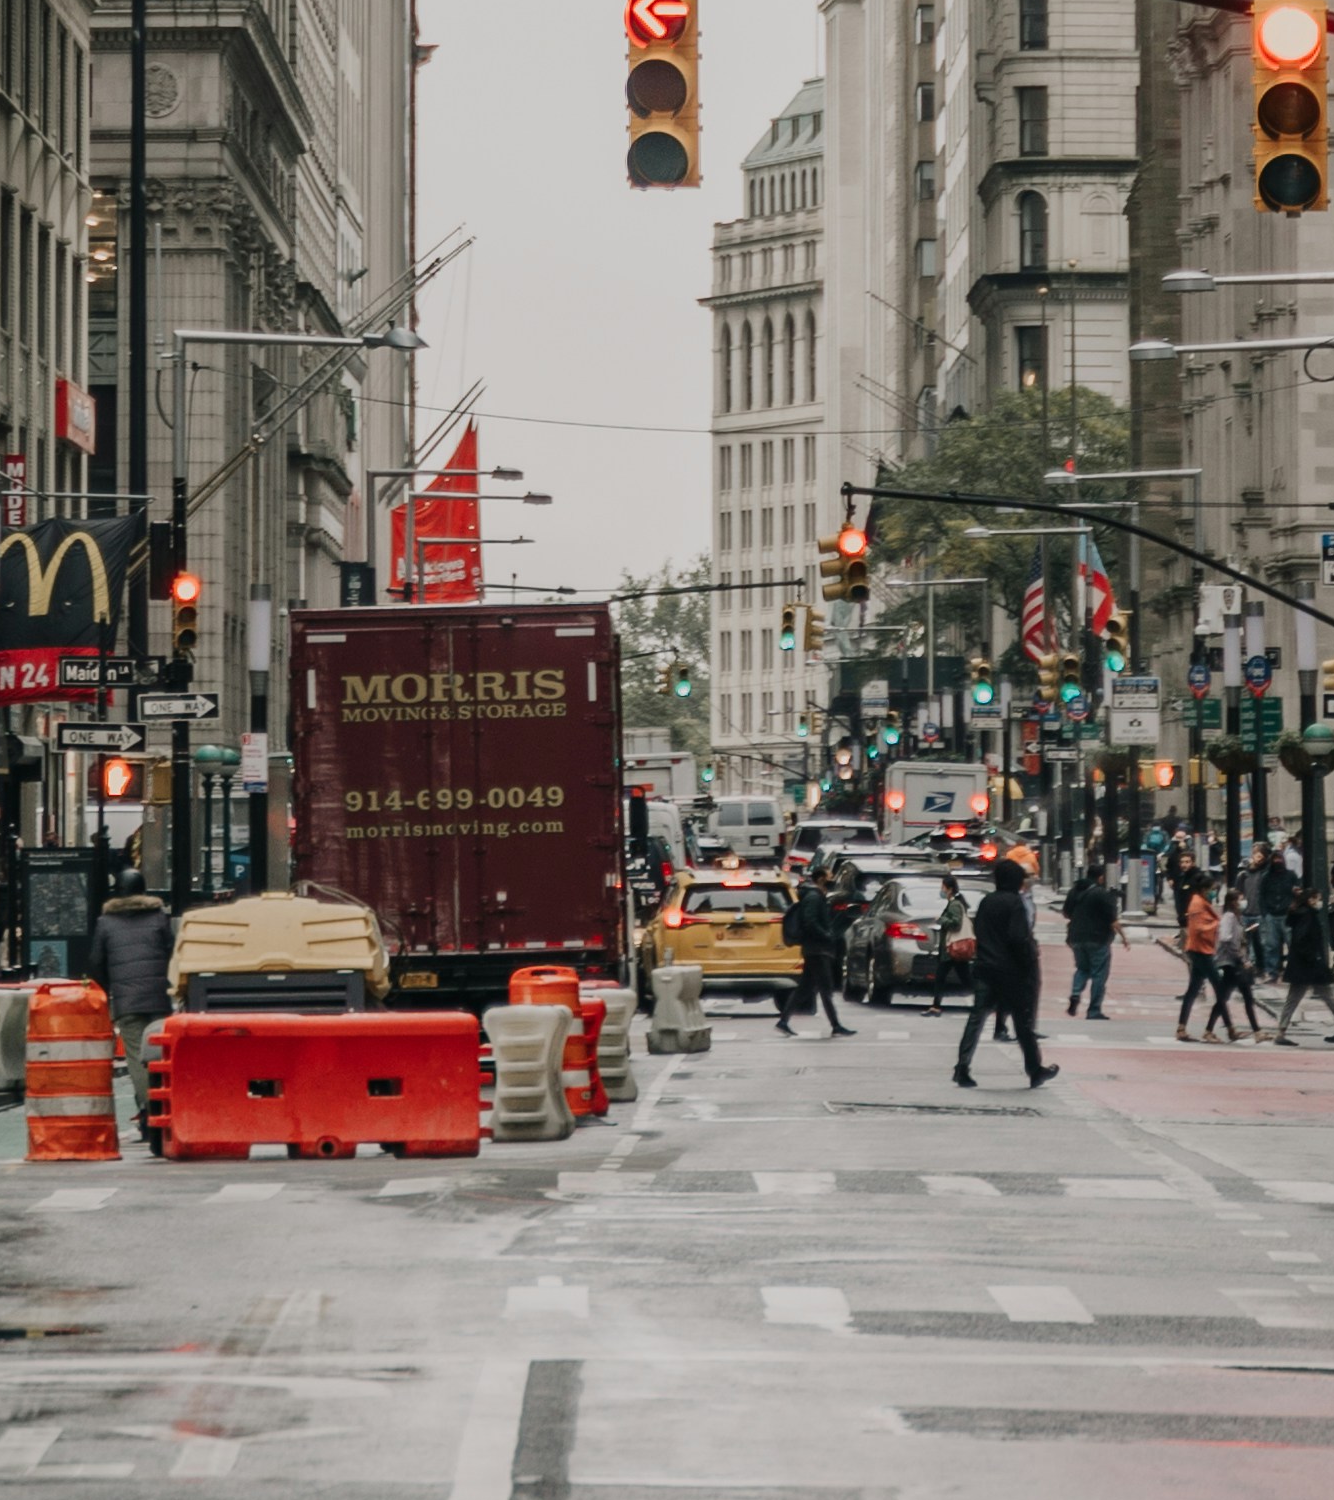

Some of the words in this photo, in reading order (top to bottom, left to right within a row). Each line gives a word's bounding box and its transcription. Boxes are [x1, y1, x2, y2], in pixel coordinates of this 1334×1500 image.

[20, 662, 50, 689] 24
[65, 661, 117, 681] Maidn
[341, 669, 567, 705] MORRIS
[150, 701, 174, 714] ONE
[184, 700, 208, 712] WAY
[342, 706, 438, 722] MOVING
[458, 702, 567, 720] STORAGE
[69, 731, 95, 744] ONE
[107, 731, 134, 745] WAY
[345, 786, 565, 813] 914-699-0049
[346, 819, 565, 839] morrismoving.com
[234, 864, 245, 878] P
